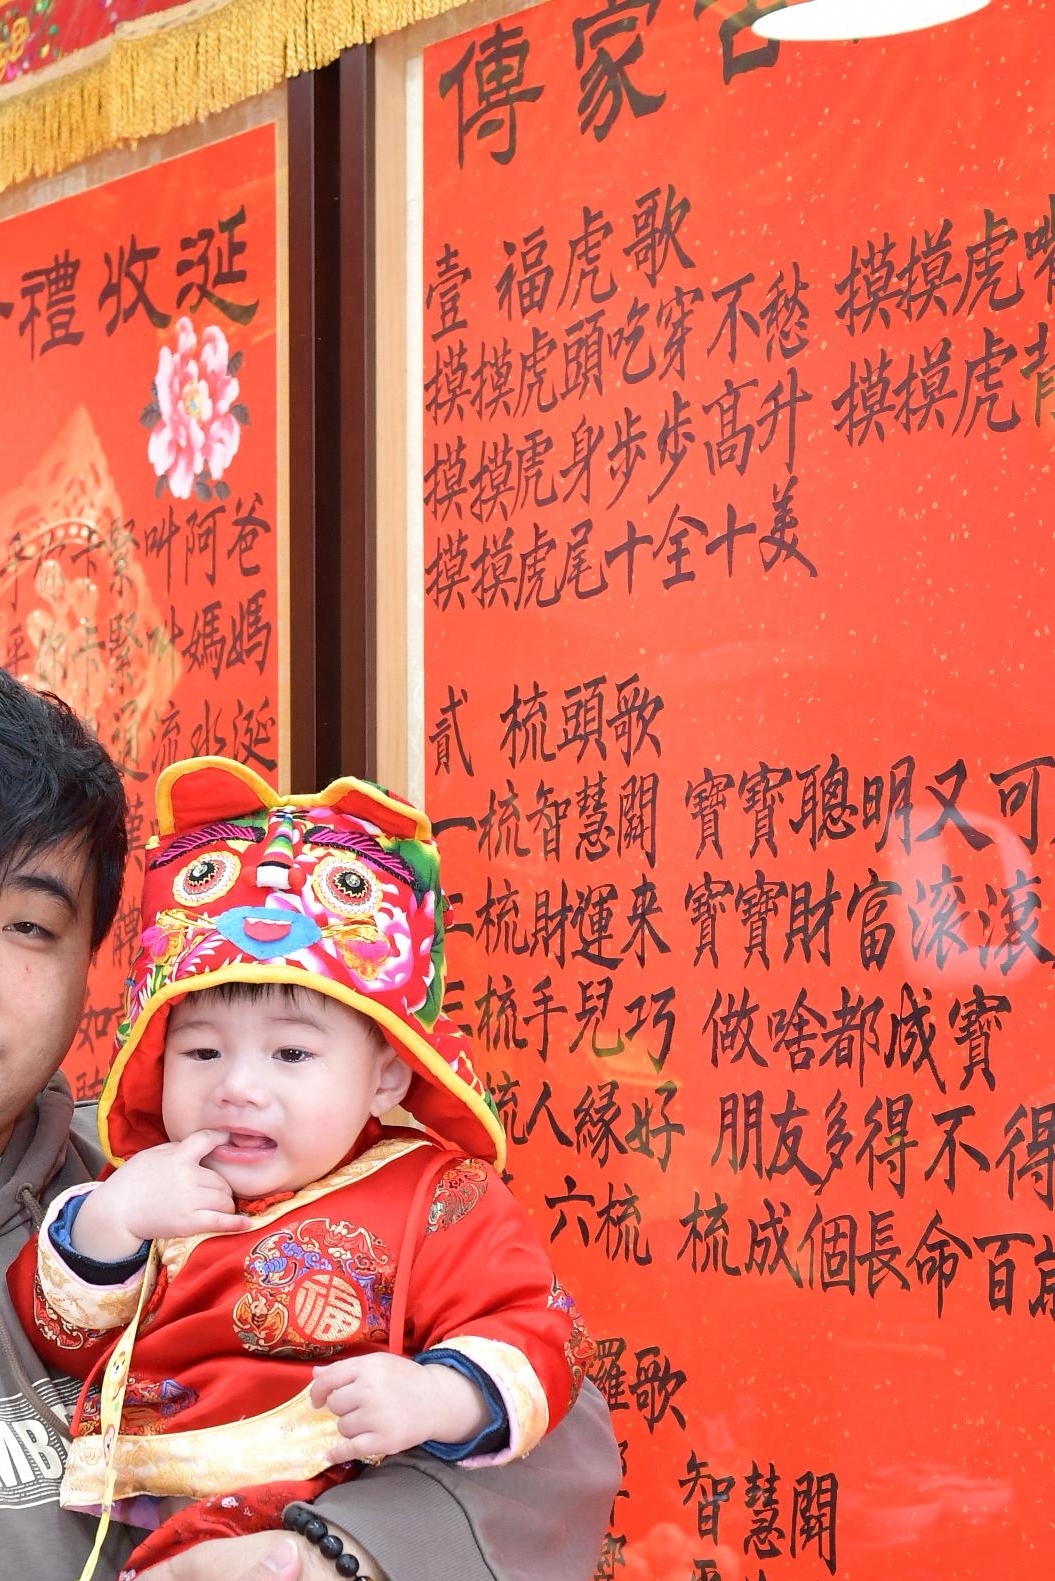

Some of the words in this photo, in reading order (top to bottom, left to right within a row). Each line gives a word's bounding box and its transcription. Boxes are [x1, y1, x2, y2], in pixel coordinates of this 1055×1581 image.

[425, 243, 471, 342] 壹
[495, 184, 696, 322] 福虎歌
[424, 261, 812, 423] 摸摸虎頭吃穿不愁
[425, 475, 817, 612] 摸摸虎尾十全十美
[428, 685, 473, 777] 貳
[500, 672, 664, 769] 梳頭歌
[431, 771, 659, 869] 一梳智慧開
[702, 982, 1013, 1094] 做啥都成寶
[679, 1450, 840, 1576] 智慧開
